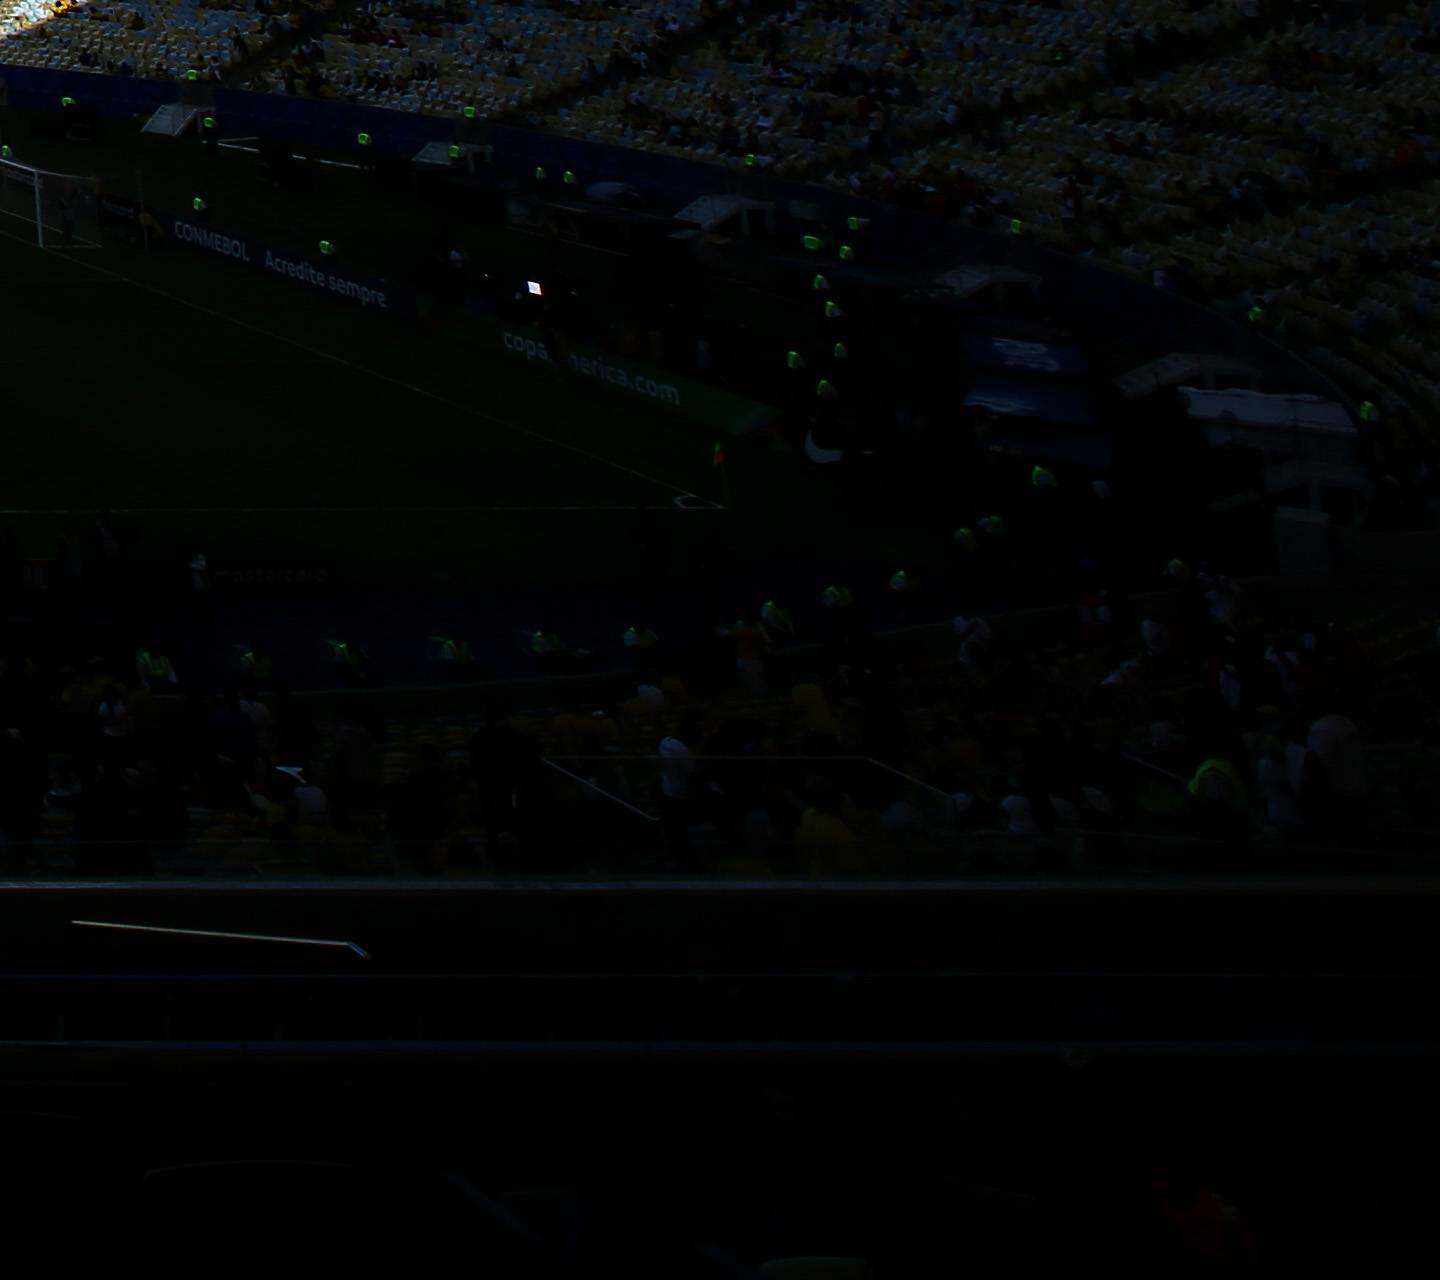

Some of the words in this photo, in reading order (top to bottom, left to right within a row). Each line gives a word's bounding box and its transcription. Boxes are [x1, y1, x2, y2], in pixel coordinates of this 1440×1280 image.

[174, 221, 251, 263] CONMEBOL
[264, 250, 327, 290] Acredite
[328, 277, 387, 309] sempre
